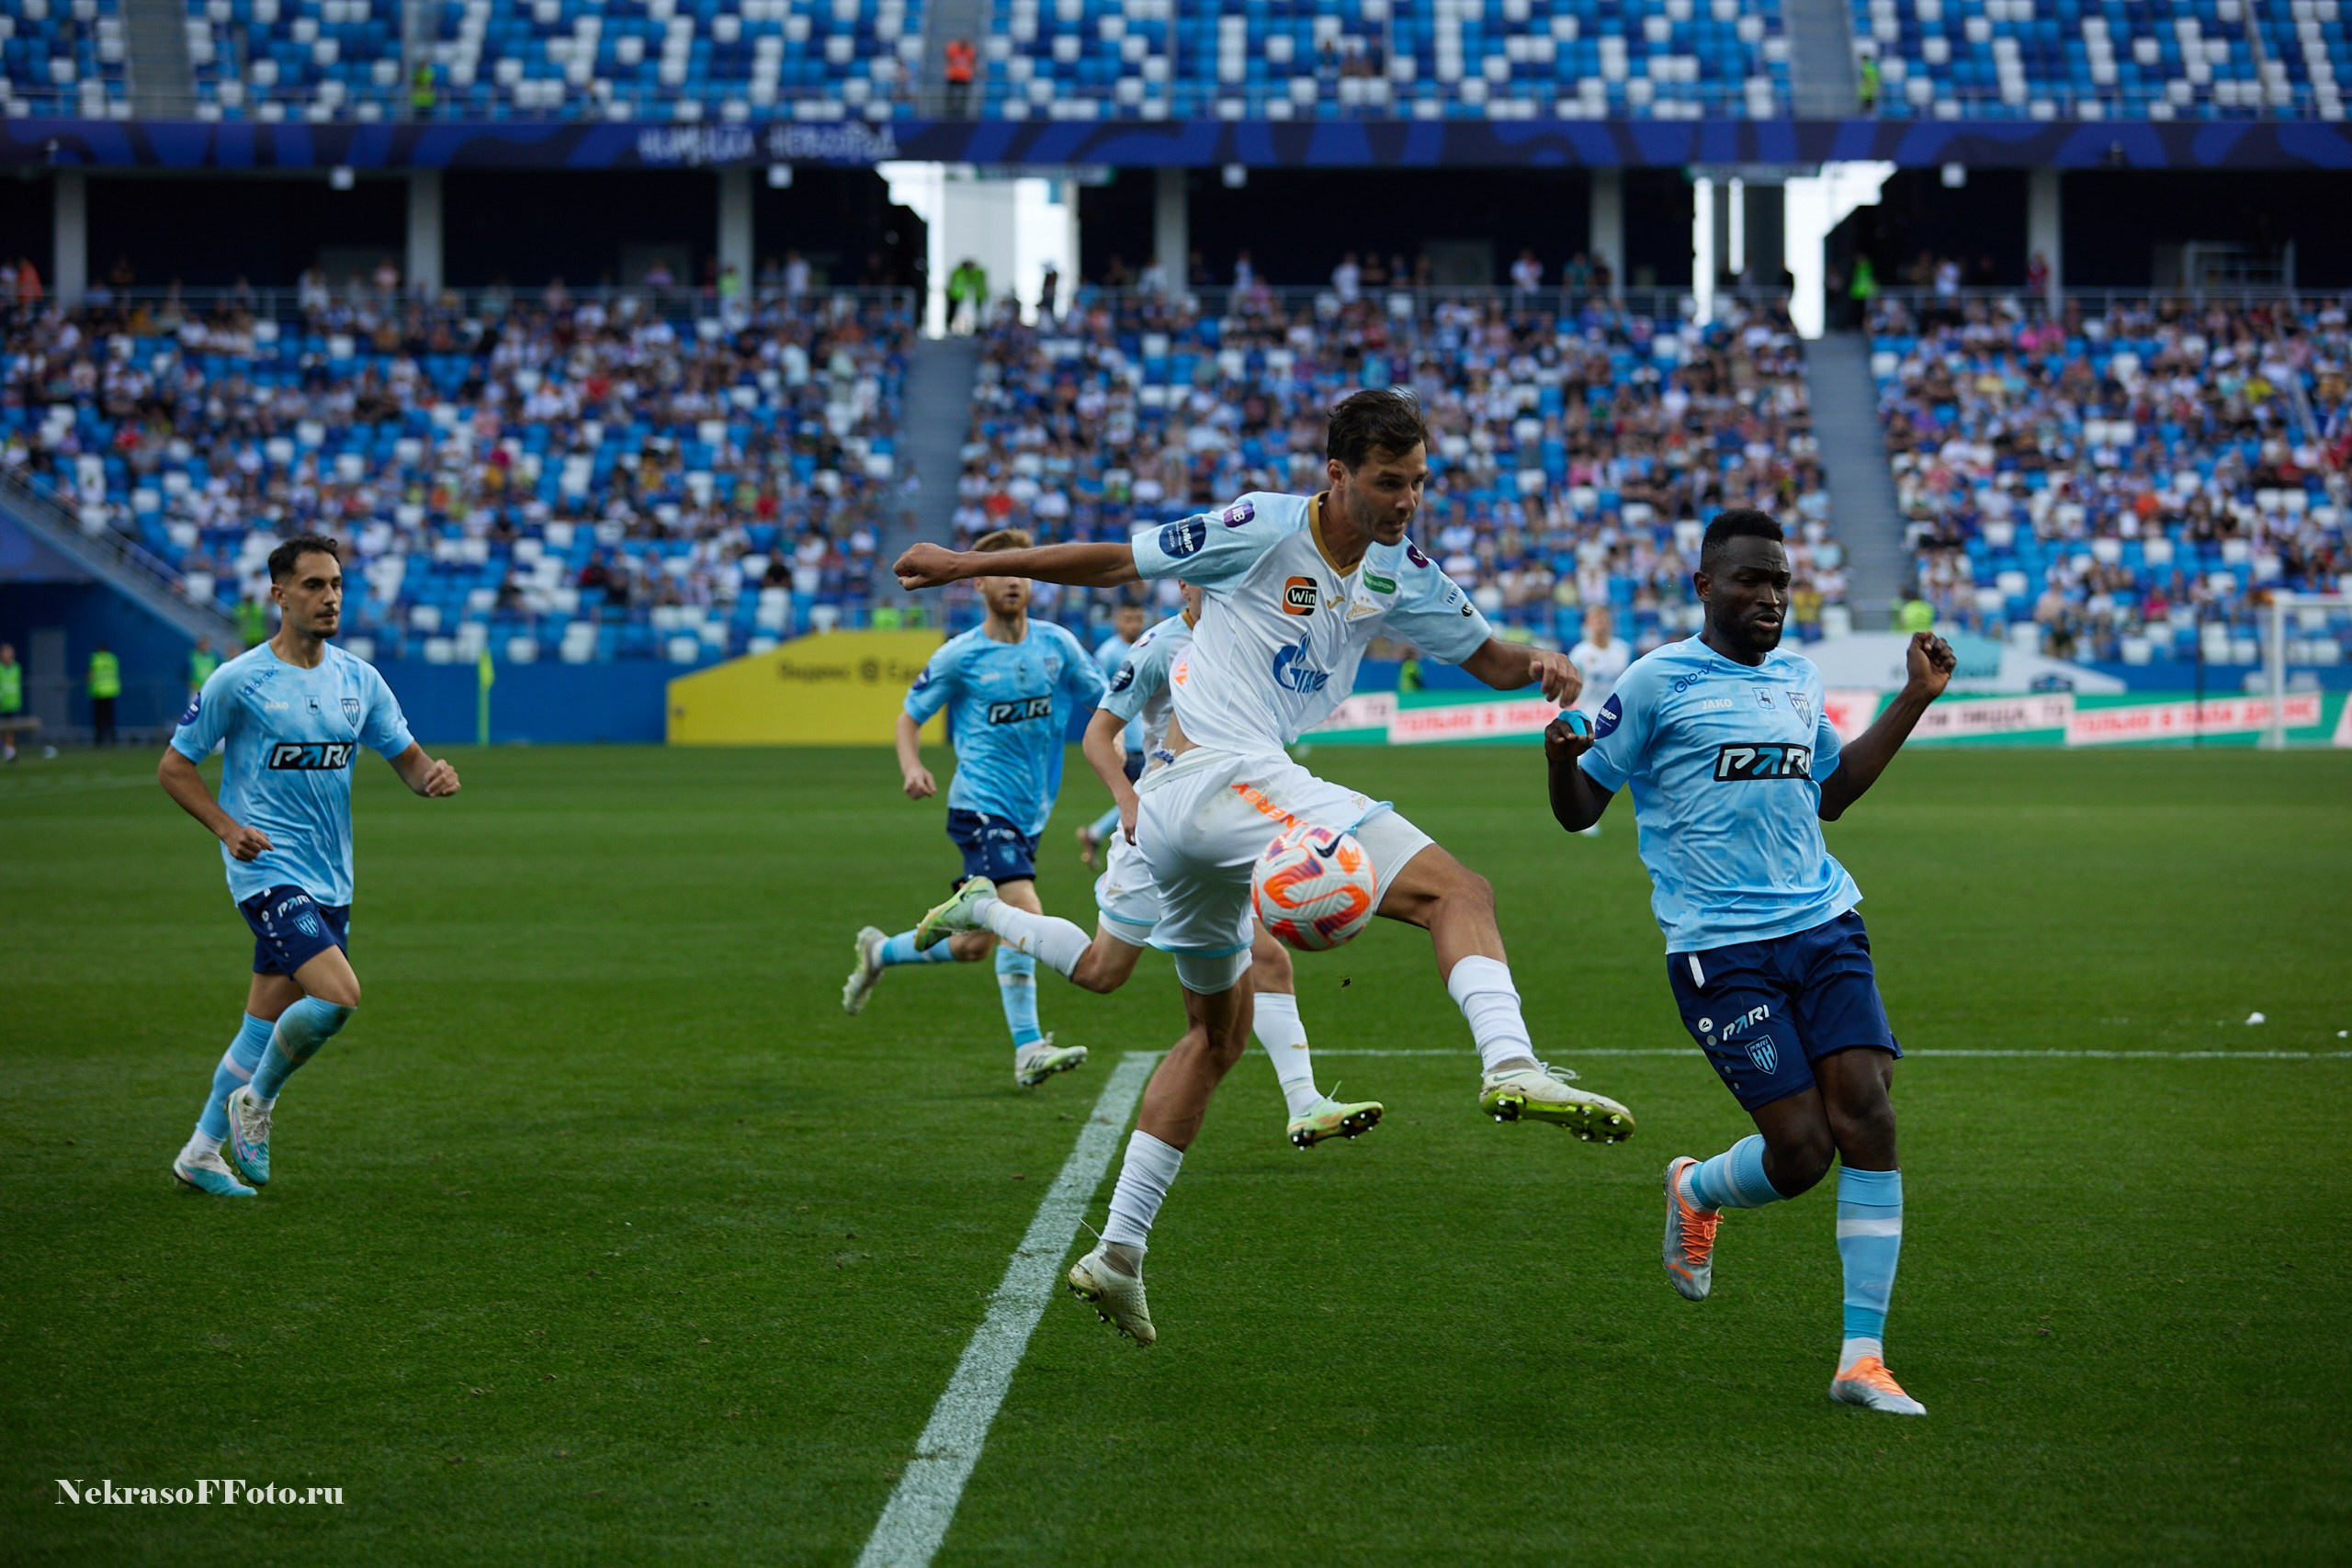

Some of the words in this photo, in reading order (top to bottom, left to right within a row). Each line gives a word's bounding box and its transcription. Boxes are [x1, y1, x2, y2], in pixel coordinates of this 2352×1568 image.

[1702, 698, 1734, 710] JAKO
[273, 744, 353, 767] PARI
[1718, 747, 1810, 777] PARI
[1230, 783, 1308, 829] NERGY
[1723, 1004, 1770, 1042] PARI
